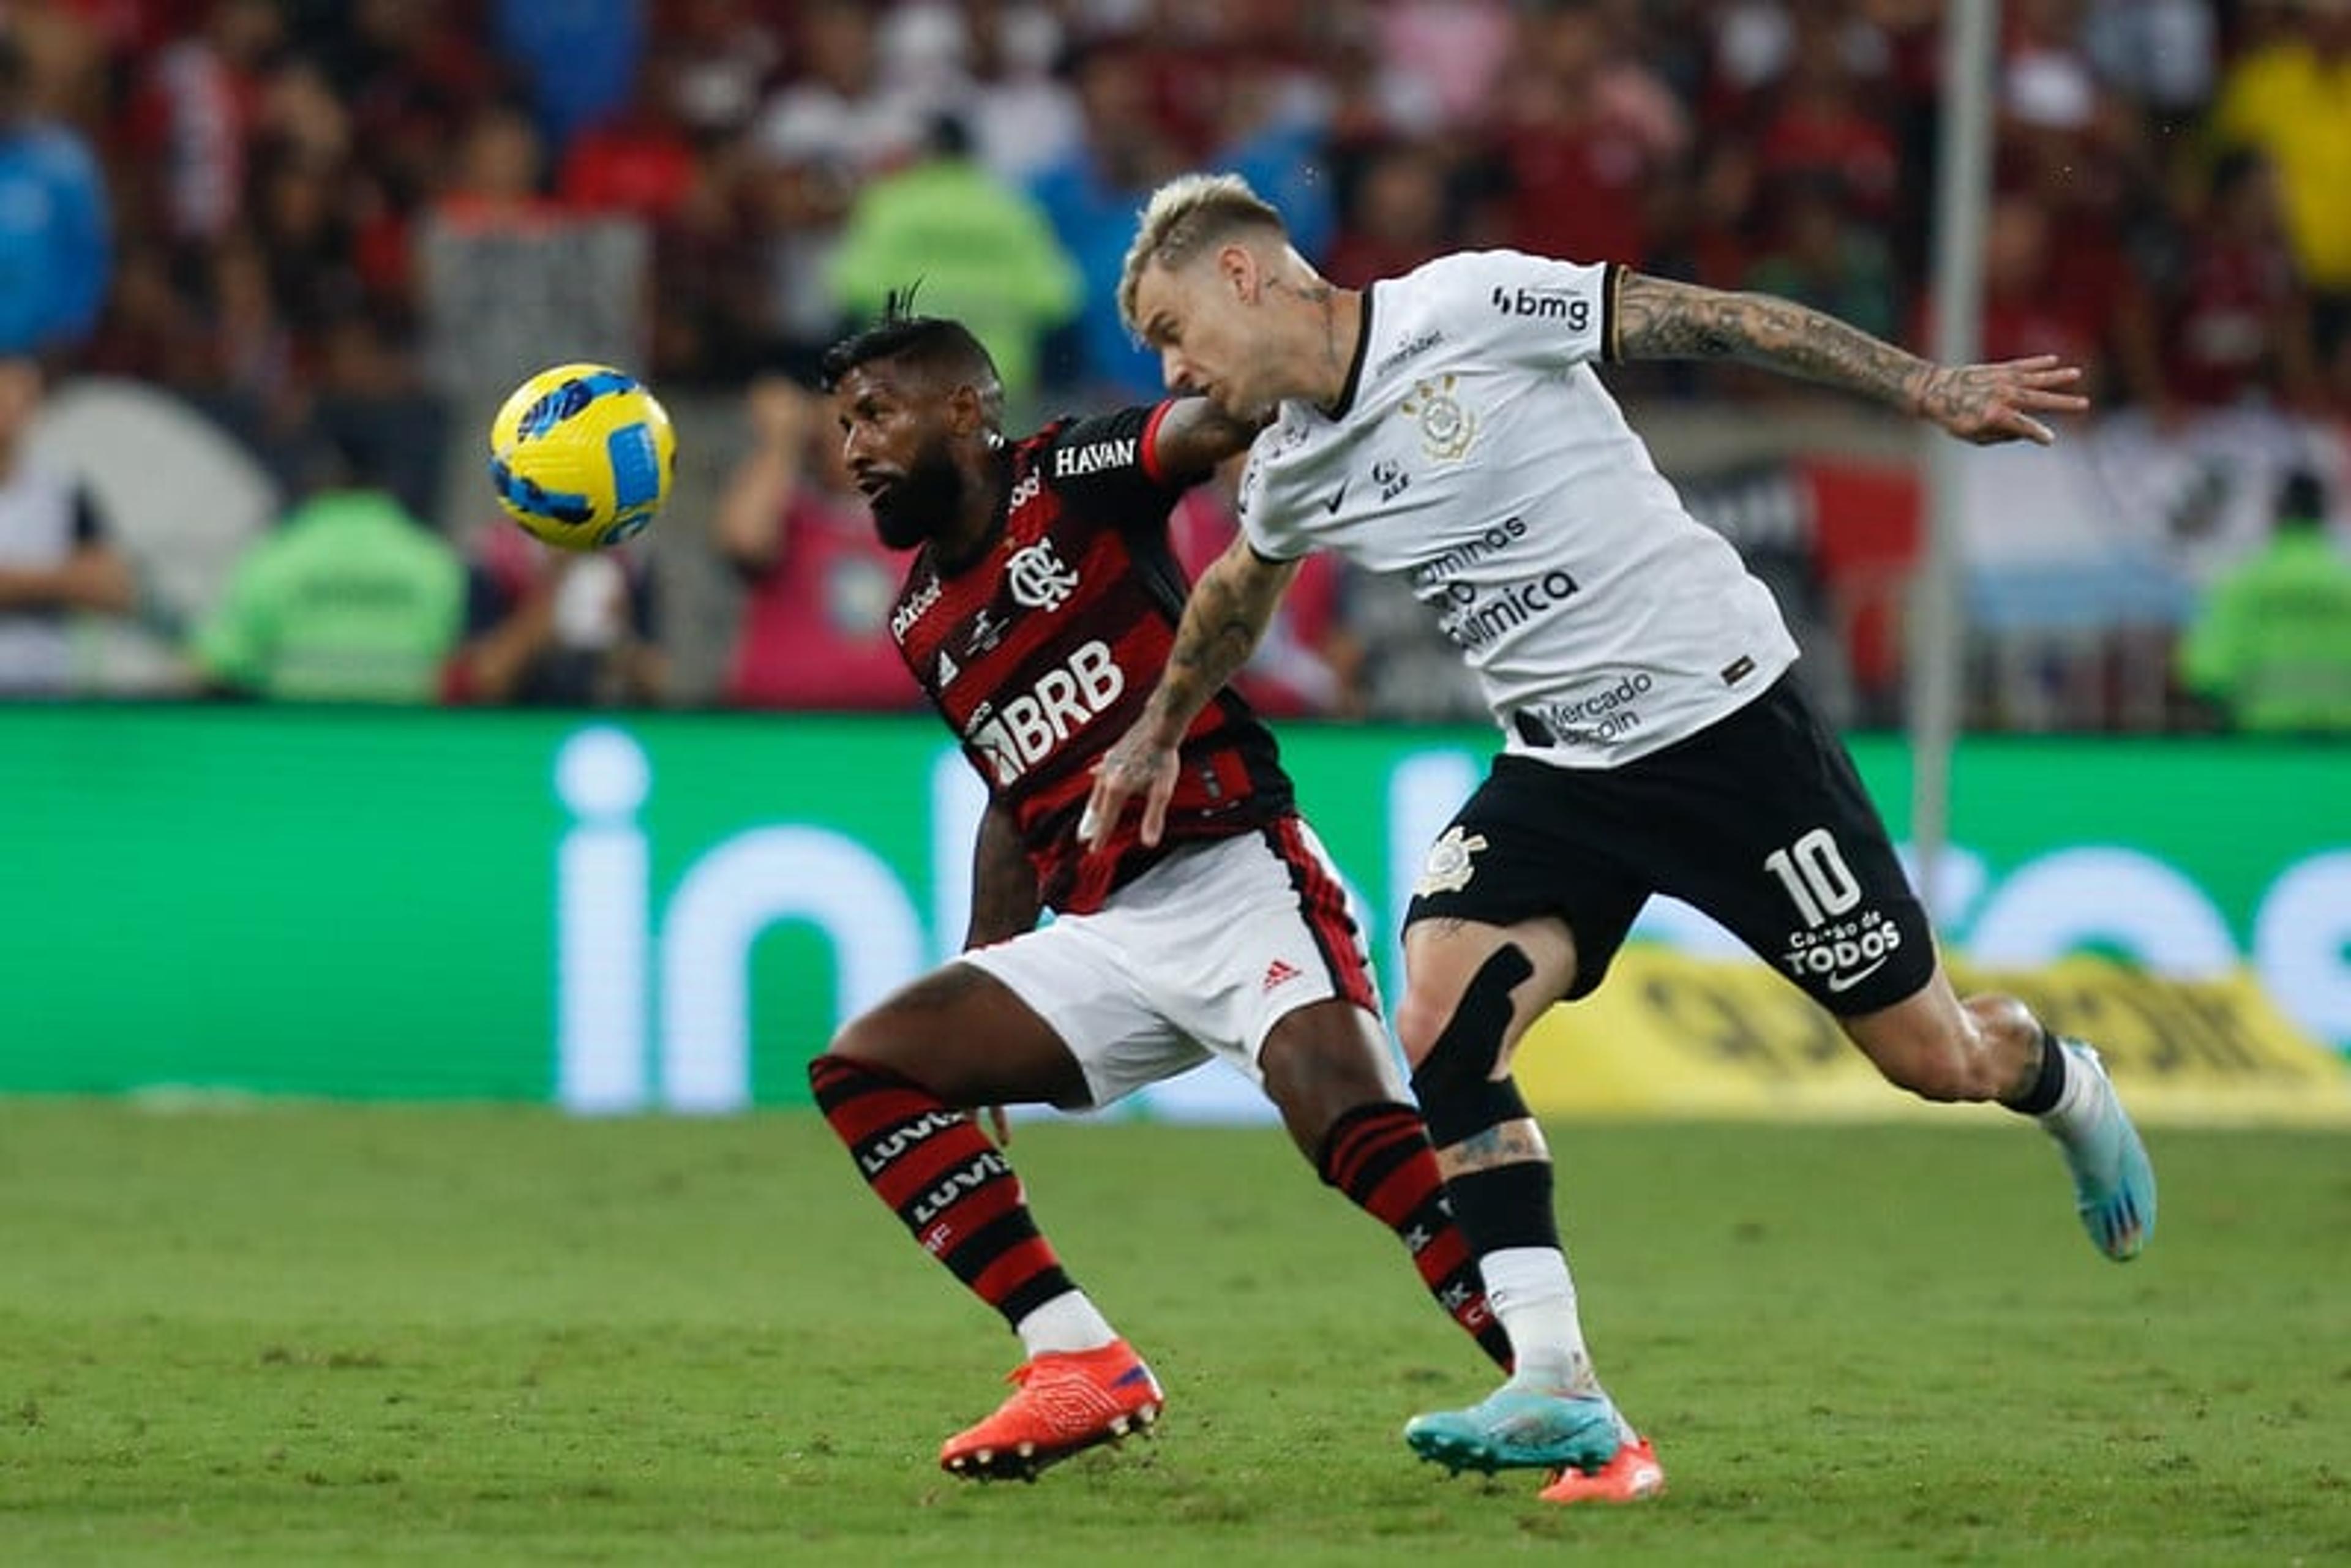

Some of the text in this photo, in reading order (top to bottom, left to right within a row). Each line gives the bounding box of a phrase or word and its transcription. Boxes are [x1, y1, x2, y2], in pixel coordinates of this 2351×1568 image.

[1515, 287, 1590, 332] bmg
[1055, 437, 1137, 478] HAVAN
[1000, 640, 1125, 764] BRB
[1539, 673, 1652, 726] Mercado
[1764, 828, 1861, 929] 10
[1782, 921, 1900, 975] TODOS
